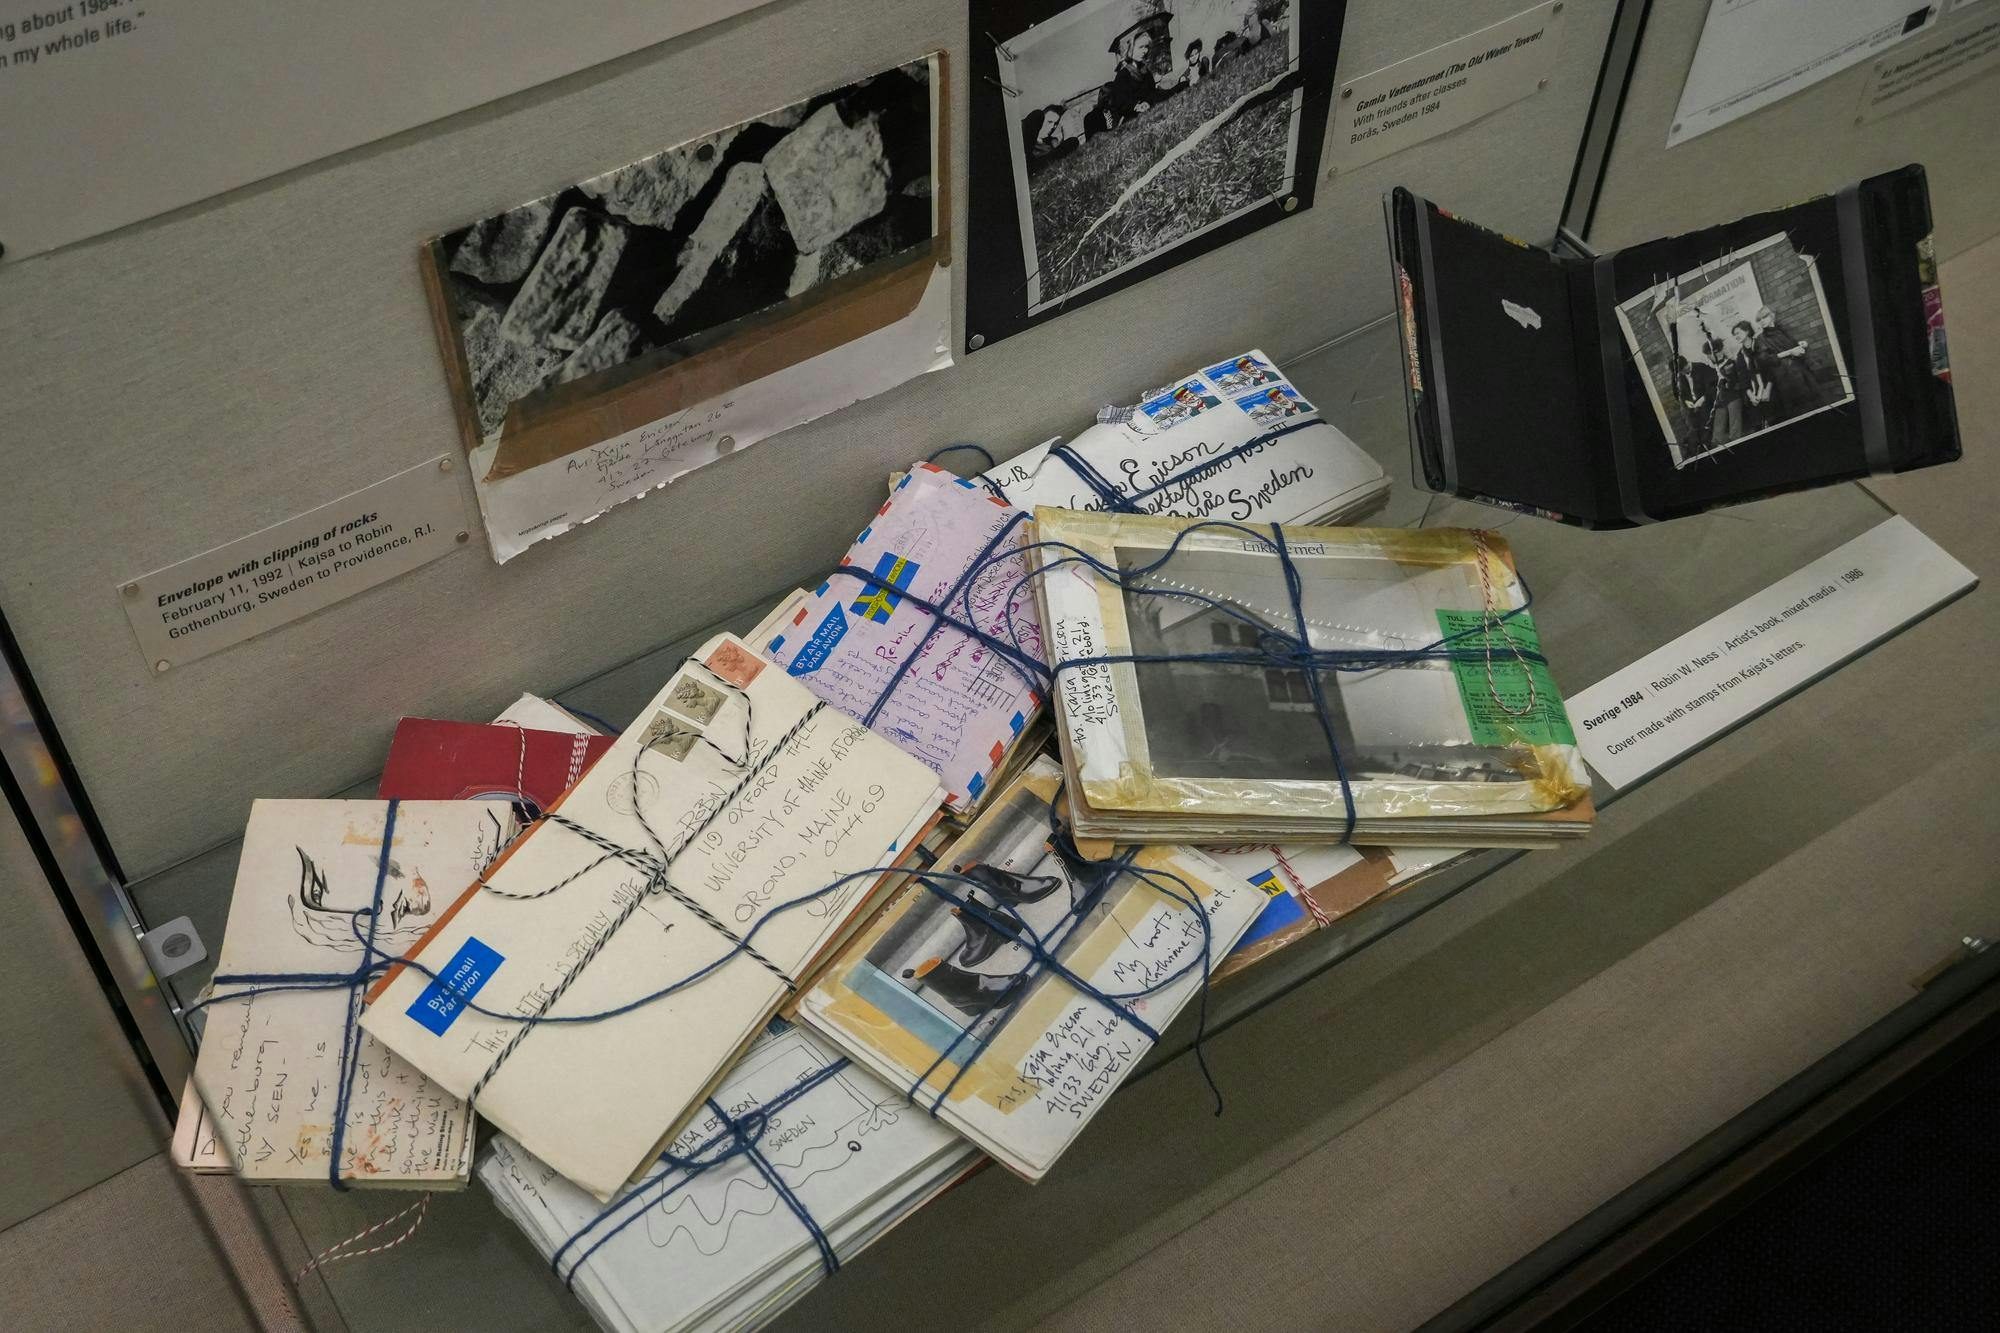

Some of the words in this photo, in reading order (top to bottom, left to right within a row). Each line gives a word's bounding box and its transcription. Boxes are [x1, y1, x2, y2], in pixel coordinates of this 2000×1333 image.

[14, 46, 39, 63] my
[45, 28, 100, 55] whole
[22, 6, 74, 34] about
[1356, 94, 1386, 112] Gamla
[1444, 62, 1467, 79] (The
[1467, 54, 1484, 69] Old
[1484, 44, 1512, 62] Water
[1513, 28, 1544, 49] Tower)
[1350, 127, 1379, 145] Borås,
[1381, 112, 1418, 132] Sweden
[1420, 101, 1441, 116] 1984
[1353, 112, 1375, 128] With
[1376, 100, 1408, 120] friends
[1409, 92, 1431, 106] after
[1433, 77, 1467, 97] classes
[1120, 440, 1225, 495] Ericson
[1229, 463, 1314, 521] Sweden
[157, 573, 224, 607] Envelope
[227, 558, 260, 580] with
[262, 535, 320, 566] clipping
[323, 525, 339, 542] of
[340, 511, 379, 534] rocks
[162, 593, 226, 624] February
[229, 584, 249, 598] 11,
[252, 568, 283, 588] 1992
[297, 548, 336, 570] Kajsa
[338, 541, 353, 554] to
[355, 523, 393, 546] Robin
[1294, 543, 1325, 555] med
[168, 601, 256, 640] Gothenburg,
[258, 574, 314, 604] Sweden
[316, 567, 331, 581] to
[334, 534, 412, 573] Providence,
[414, 524, 436, 540] R.I.
[795, 657, 808, 670] BY
[805, 635, 824, 656] AIR
[817, 614, 841, 639] MAIL
[806, 650, 825, 669] PAR
[822, 624, 844, 651] AVION
[875, 622, 917, 664] Robin
[1071, 629, 1082, 645] 21
[1582, 704, 1623, 731] Sverige
[1619, 690, 1645, 711] 1984
[1651, 672, 1682, 693] Robin
[1677, 662, 1696, 678] W.
[1695, 649, 1720, 669] Ness
[1756, 615, 1785, 635] book,
[1781, 599, 1811, 621] mixed
[1807, 583, 1838, 606] media
[1840, 567, 1865, 586] 1986
[1067, 677, 1081, 718] Kajsa
[1092, 684, 1103, 700] 33
[1094, 705, 1106, 724] 411
[1606, 735, 1639, 757] Cover
[1637, 719, 1665, 740] made
[1663, 708, 1687, 728] with
[1684, 687, 1721, 714] stamps
[1716, 674, 1744, 696] from
[1773, 639, 1807, 663] letters.
[697, 830, 724, 856] 119
[785, 722, 819, 757] HALL
[703, 809, 786, 892] UNIVERSITY
[783, 790, 801, 817] OF
[799, 756, 833, 795] MAINE
[823, 783, 886, 858] 04469
[734, 850, 807, 923] ORONO,
[797, 788, 852, 844] MAINE
[427, 993, 445, 1011] By
[442, 979, 457, 996] ar
[453, 956, 476, 982] mail
[438, 995, 458, 1018] Par
[456, 969, 482, 1000] vion
[1045, 1005, 1087, 1051] Ericson
[1071, 1026, 1096, 1049] 21
[768, 1113, 817, 1152] SWEDEN
